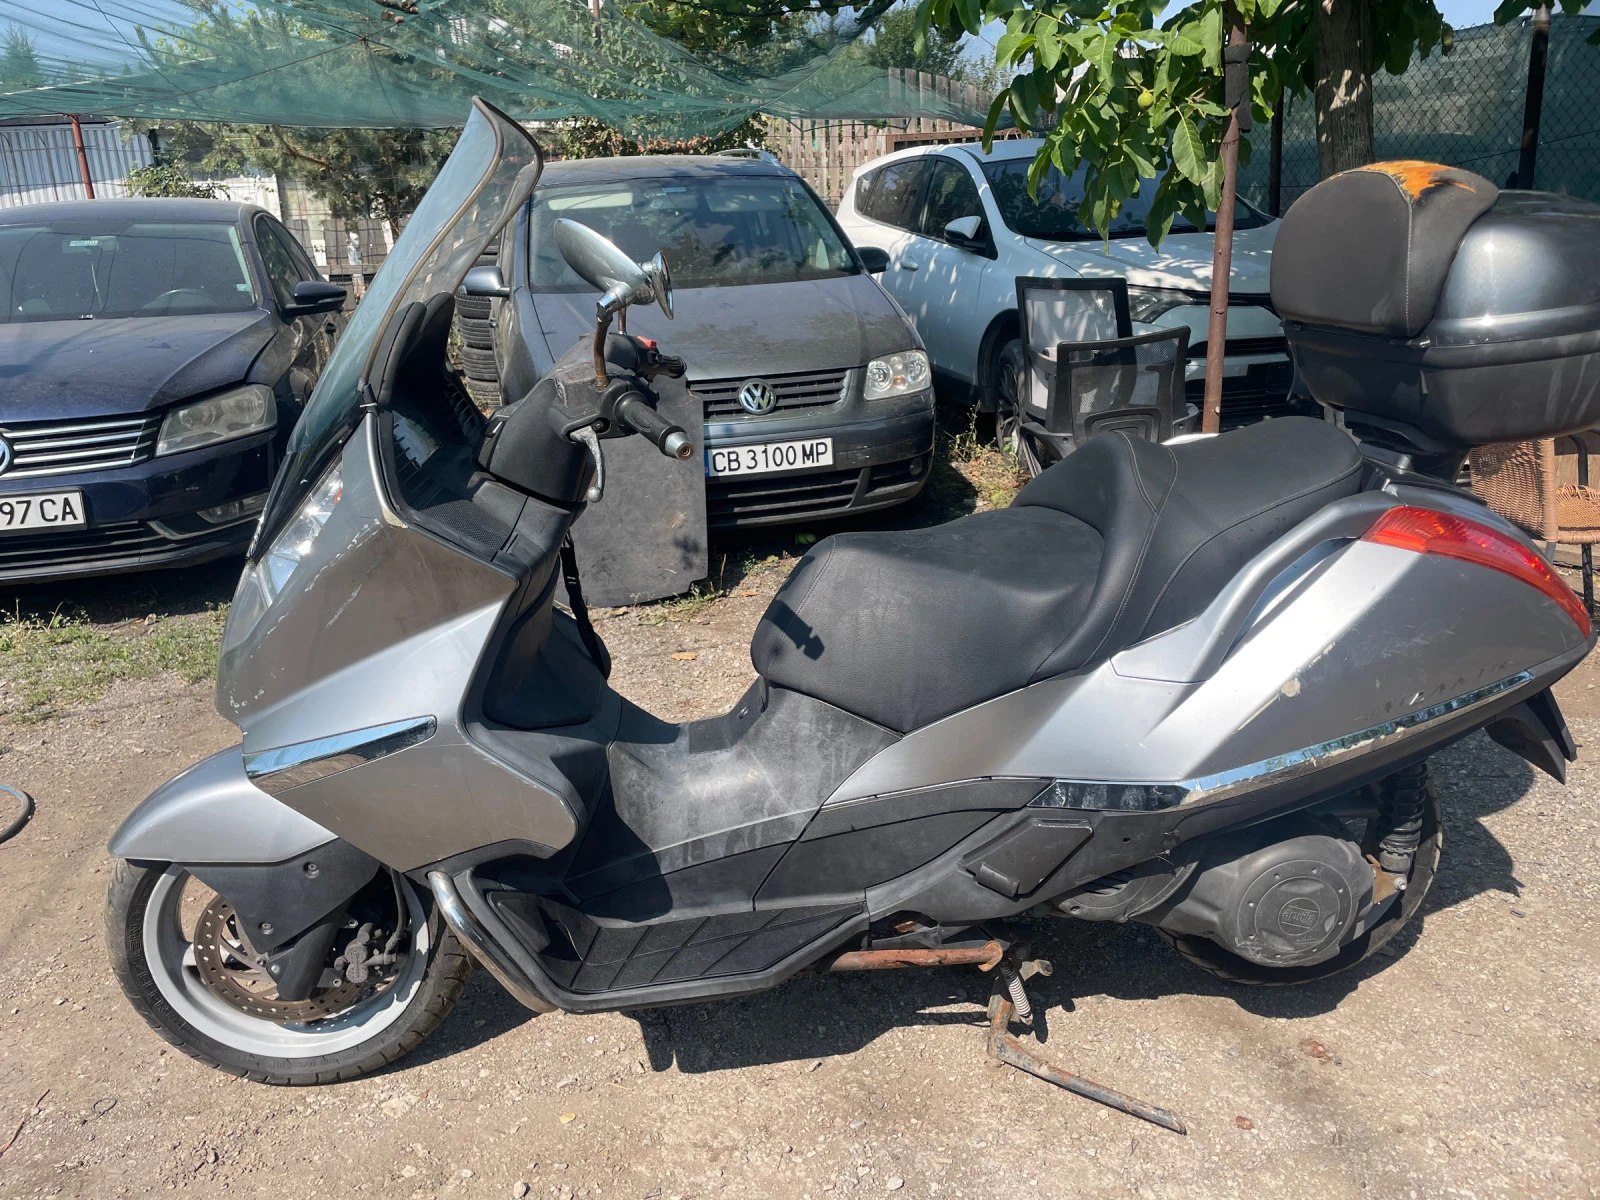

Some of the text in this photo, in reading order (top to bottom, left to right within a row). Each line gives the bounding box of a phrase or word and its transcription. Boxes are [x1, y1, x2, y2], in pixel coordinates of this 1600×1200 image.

[712, 450, 741, 473] CB
[746, 445, 797, 470] 3100
[801, 441, 829, 465] MP
[0, 497, 79, 526] 97 CA
